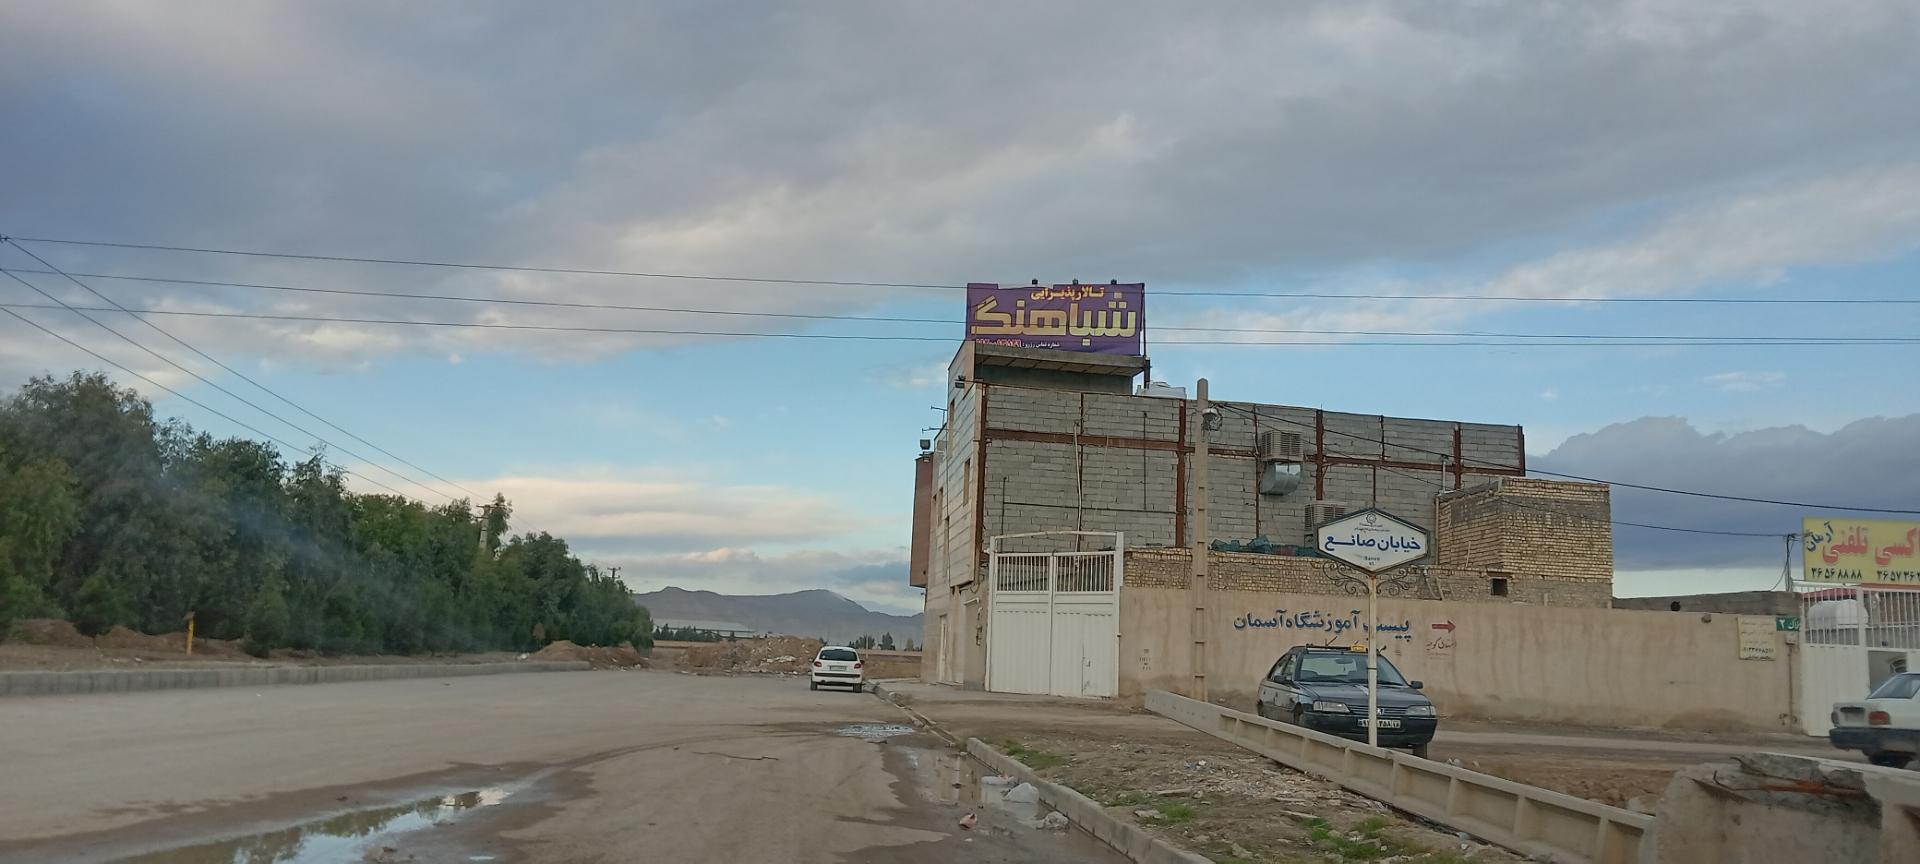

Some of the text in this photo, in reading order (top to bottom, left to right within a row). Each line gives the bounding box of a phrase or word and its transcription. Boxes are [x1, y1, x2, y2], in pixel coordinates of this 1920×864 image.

[1031, 286, 1076, 301] پذیرایی
[970, 292, 1137, 346] شباهنگ
[1324, 534, 1421, 553] خیابان صانع
[1822, 525, 1868, 564] تلفنی
[1233, 609, 1287, 630] آسمان
[1286, 610, 1361, 634] آموزشگاه
